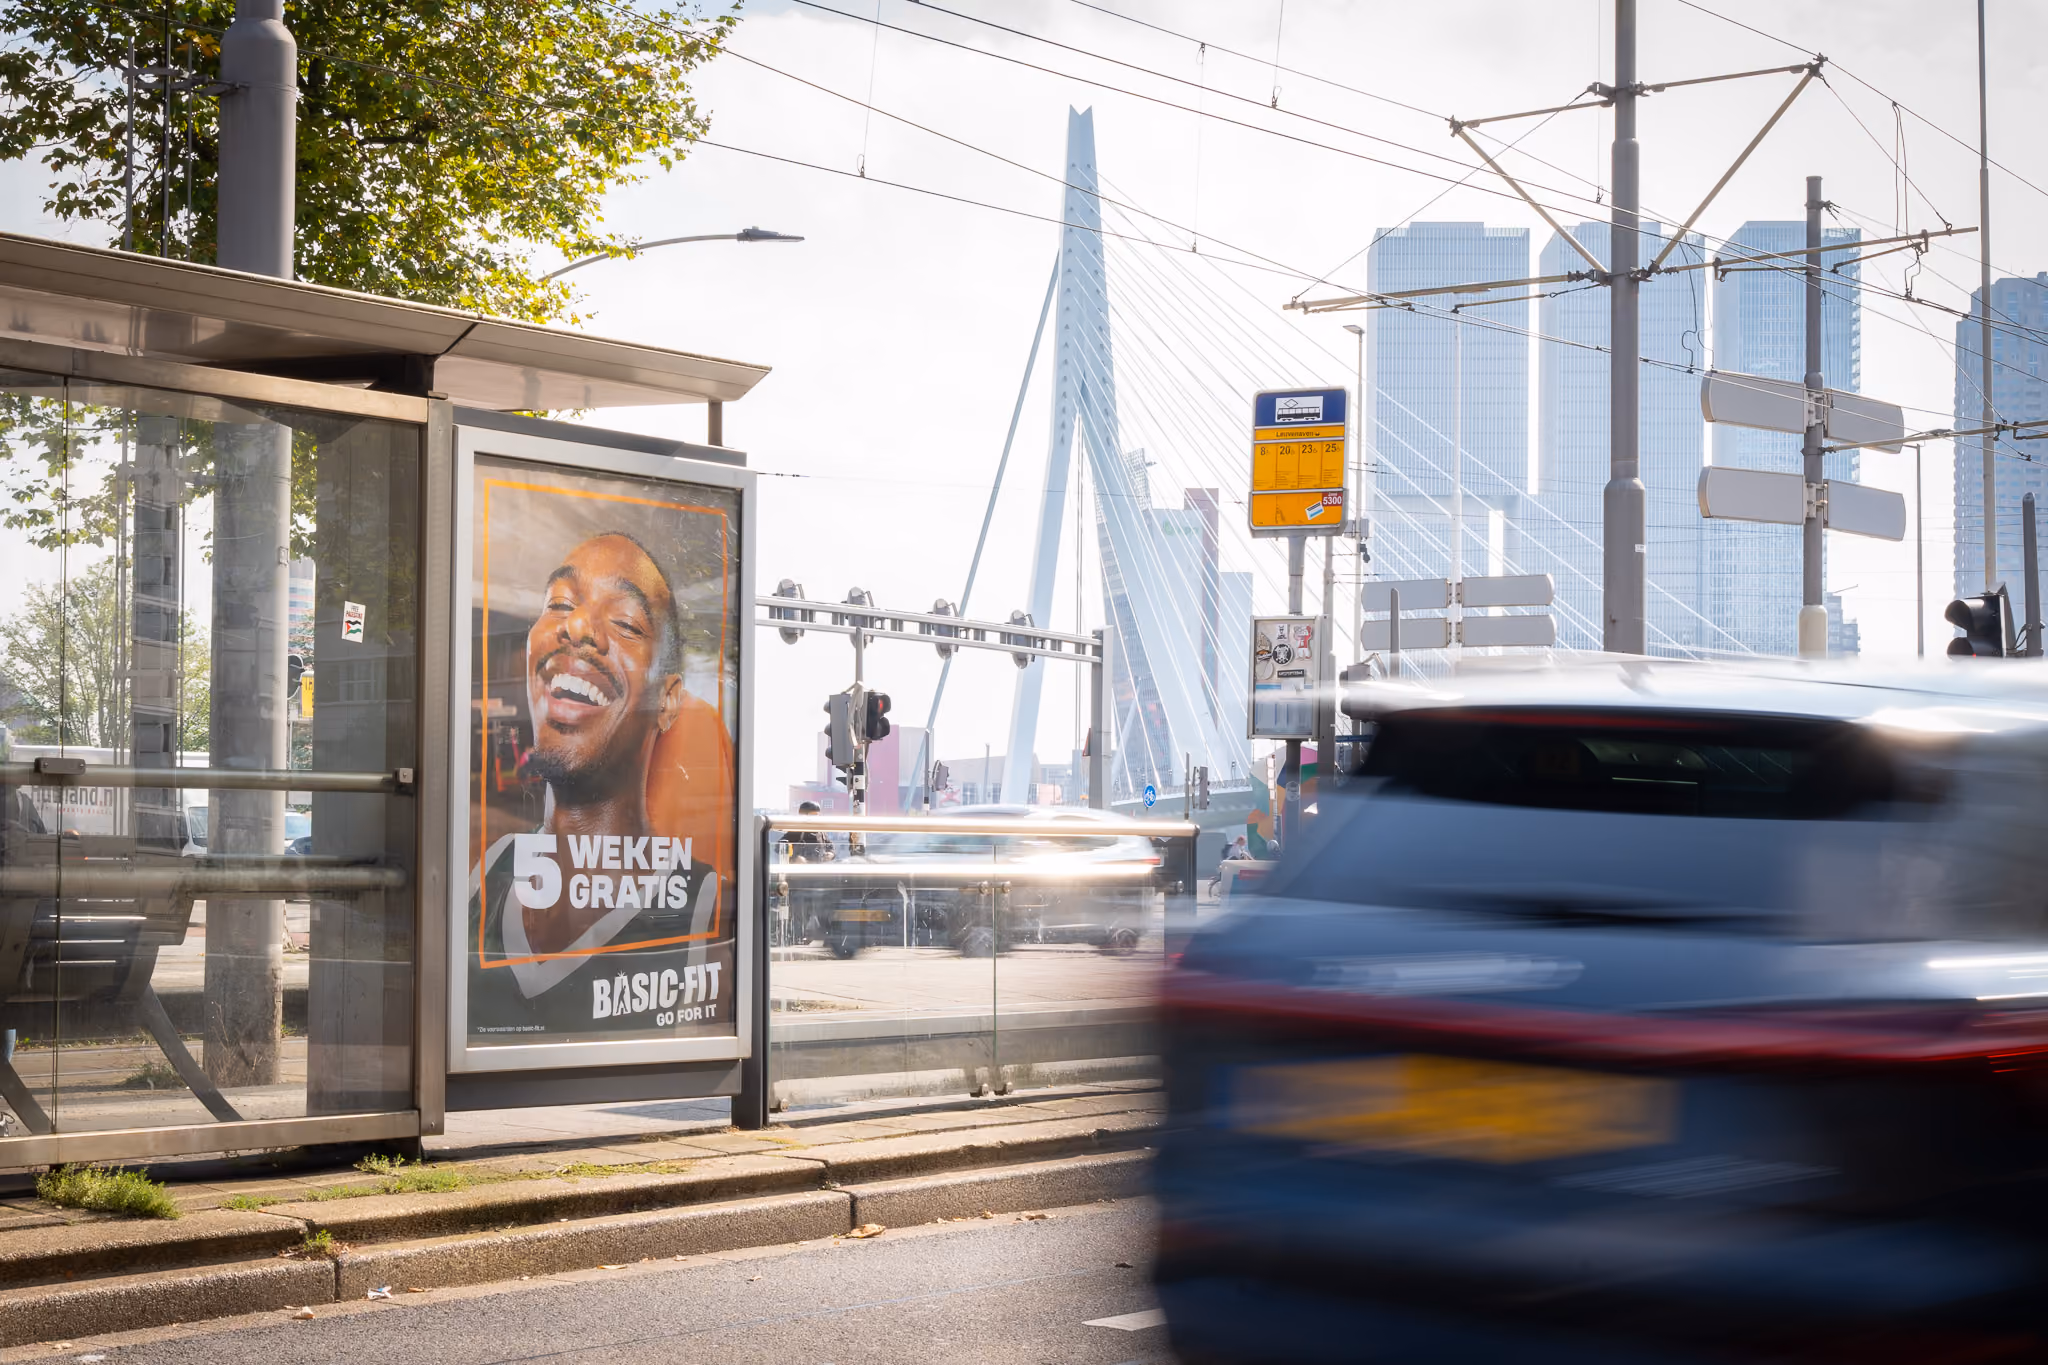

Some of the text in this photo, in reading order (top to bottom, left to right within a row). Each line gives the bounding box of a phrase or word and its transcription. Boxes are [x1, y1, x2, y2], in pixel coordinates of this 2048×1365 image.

[1260, 446, 1266, 456] 8
[1279, 445, 1291, 455] 20
[1301, 444, 1313, 454] 23
[1325, 443, 1337, 453] 25
[1322, 496, 1342, 505] 5300
[567, 834, 693, 871] WEKEN
[513, 833, 562, 909] 5
[592, 961, 722, 1019] BASIC-FIT
[656, 1003, 717, 1026] GO FOR IT
